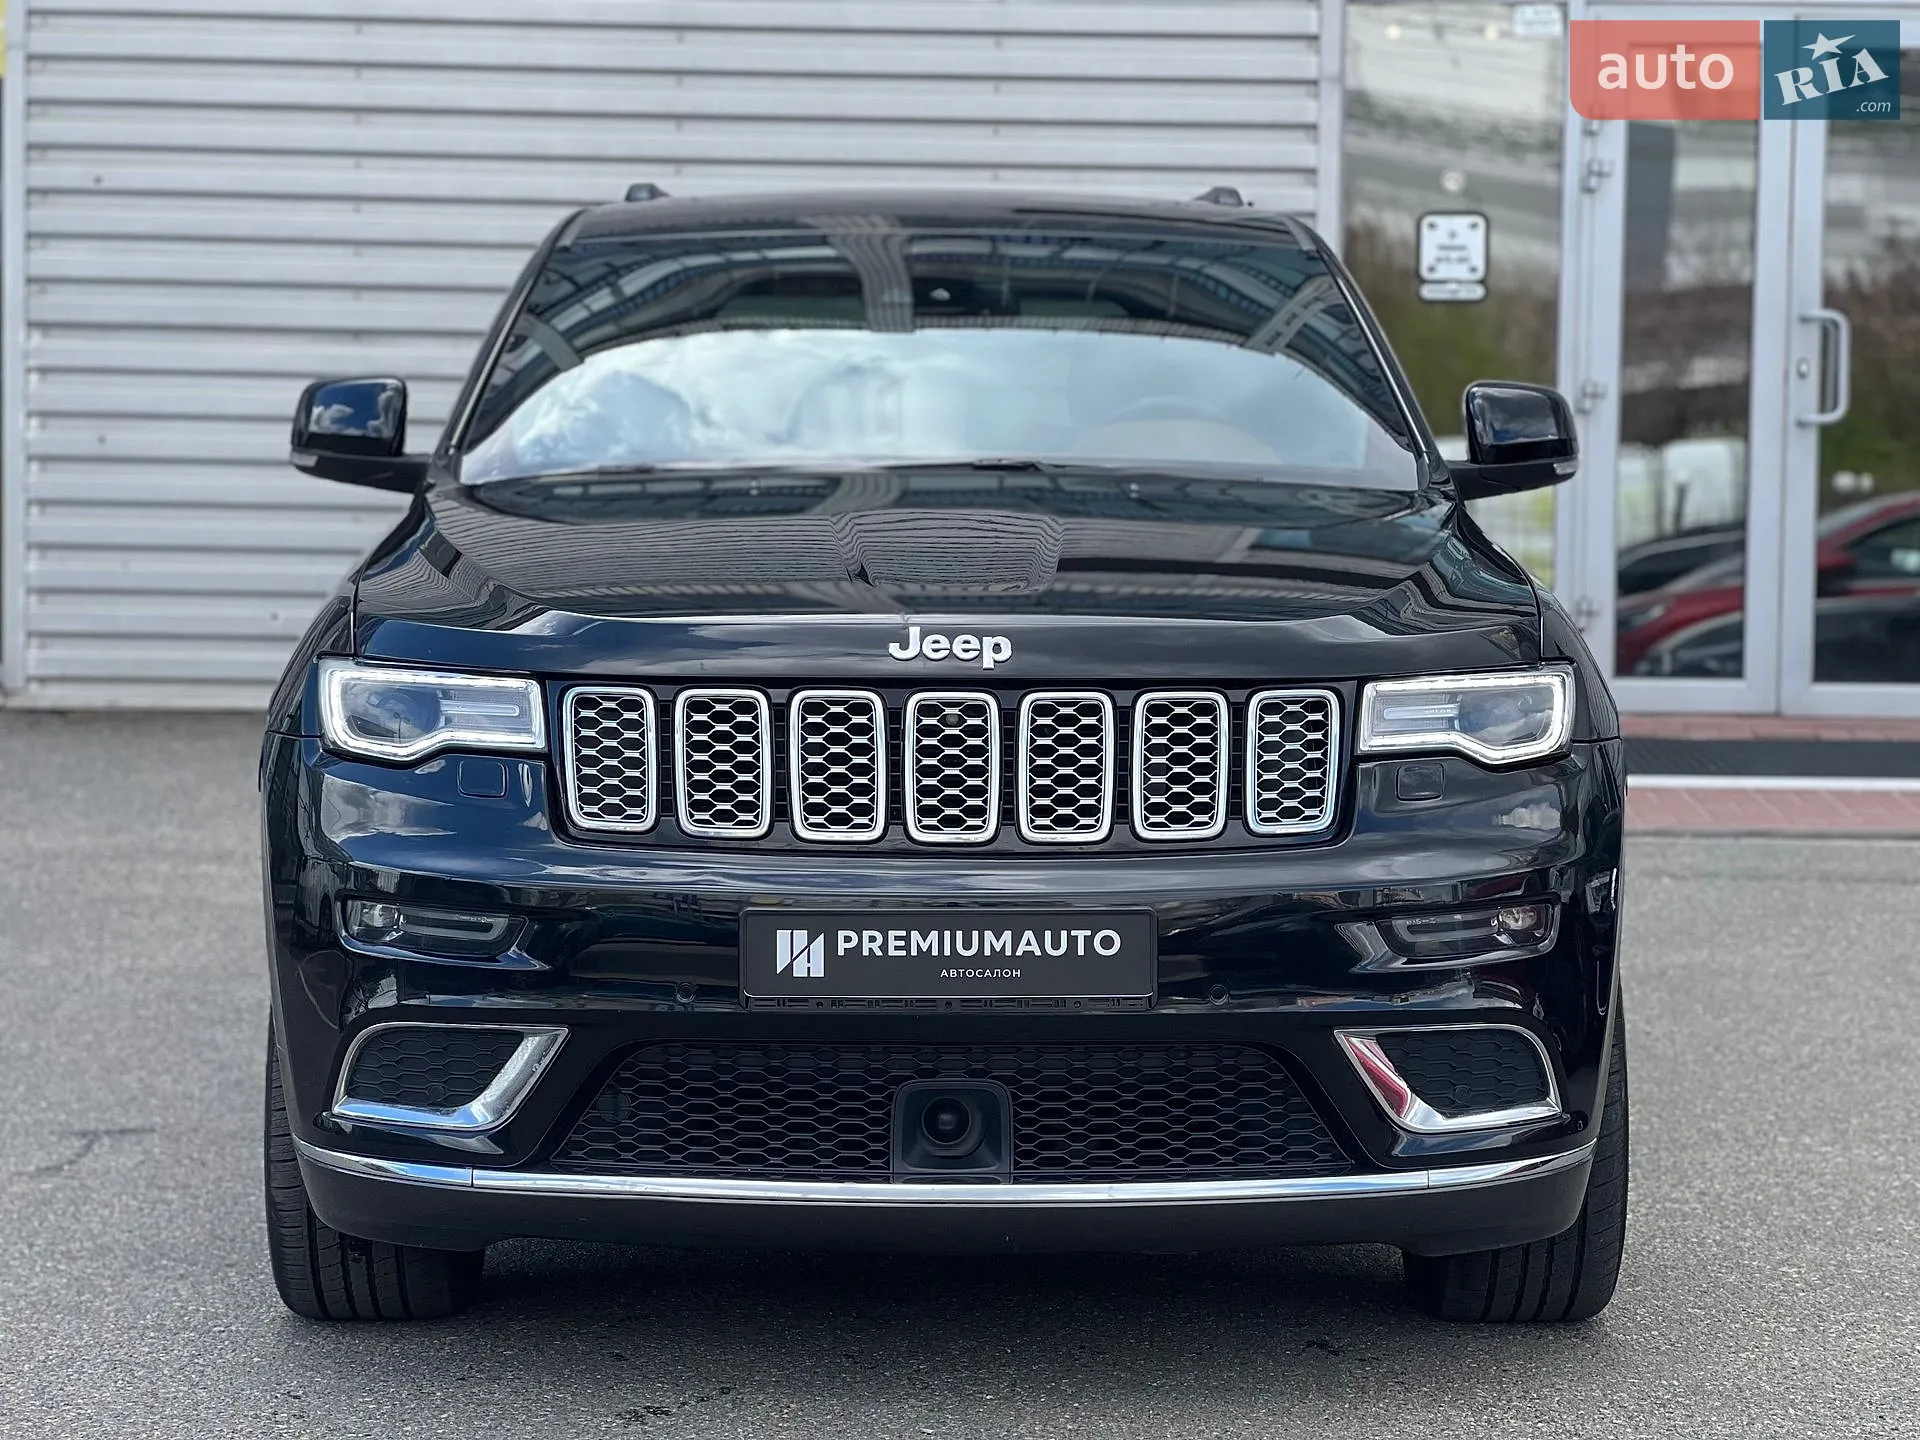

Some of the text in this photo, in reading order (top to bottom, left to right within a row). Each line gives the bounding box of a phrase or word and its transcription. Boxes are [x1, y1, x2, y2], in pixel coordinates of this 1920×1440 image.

[888, 626, 1012, 669] Jeep
[837, 929, 1121, 957] PREMIUMAUTO
[940, 968, 1021, 978] АВТОСАЛОН
